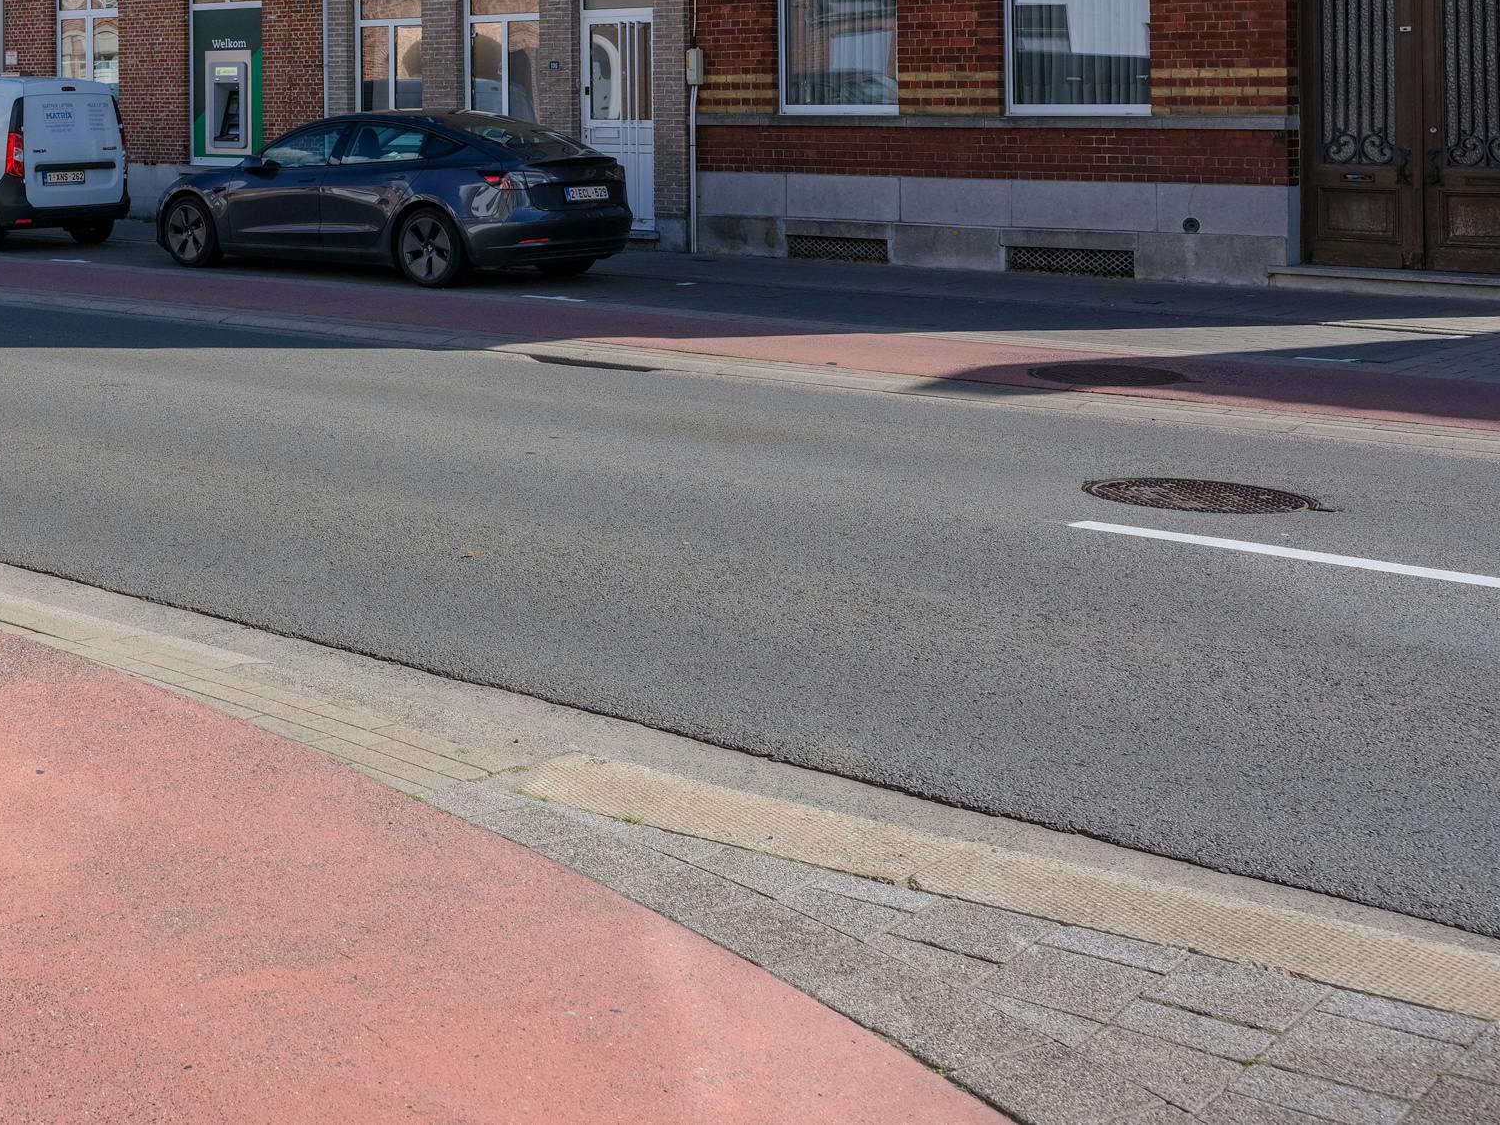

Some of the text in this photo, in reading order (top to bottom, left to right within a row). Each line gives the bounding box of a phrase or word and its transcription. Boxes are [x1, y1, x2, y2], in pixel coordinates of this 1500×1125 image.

[212, 38, 247, 49] Welkom
[45, 111, 72, 119] MATRIX
[48, 172, 84, 182] 1-XNS-262
